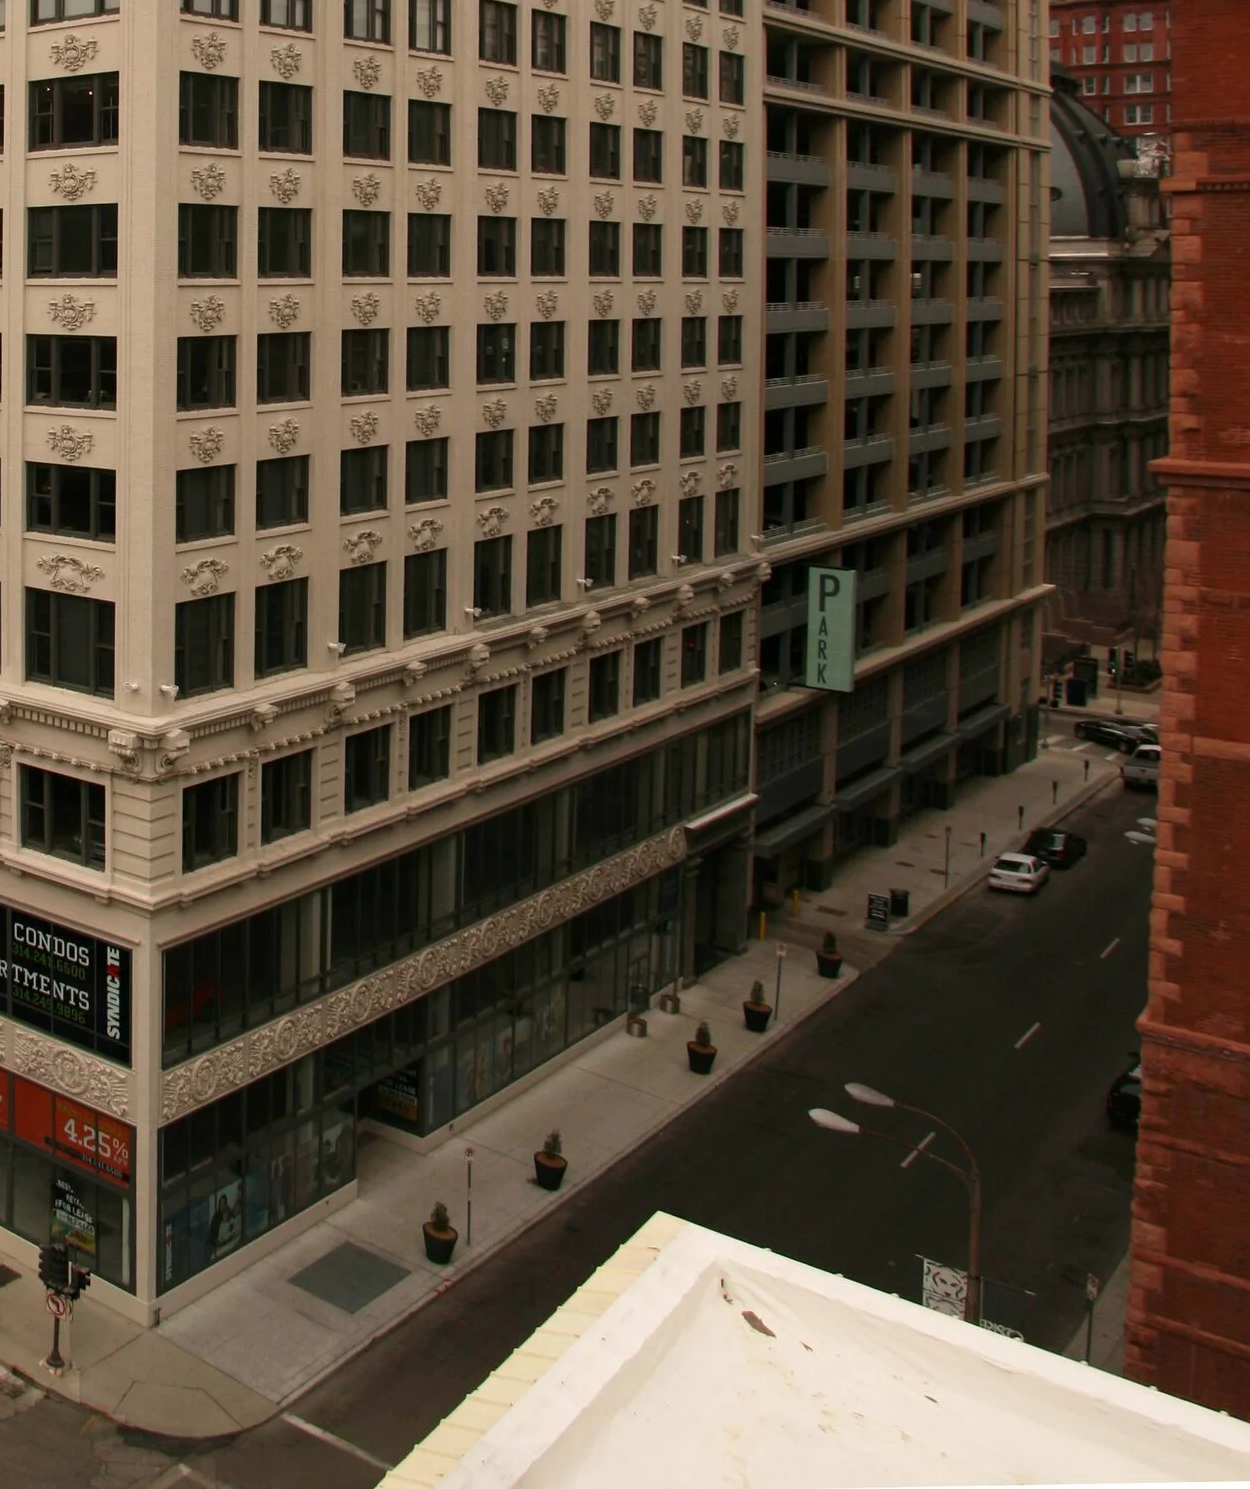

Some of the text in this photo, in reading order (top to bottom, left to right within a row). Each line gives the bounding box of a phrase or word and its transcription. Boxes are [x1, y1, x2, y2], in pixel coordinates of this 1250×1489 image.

[817, 573, 840, 684] PARK
[14, 922, 90, 967] CONDOS
[106, 946, 121, 1040] SYNDICATE
[64, 1118, 129, 1159] 4.25%
